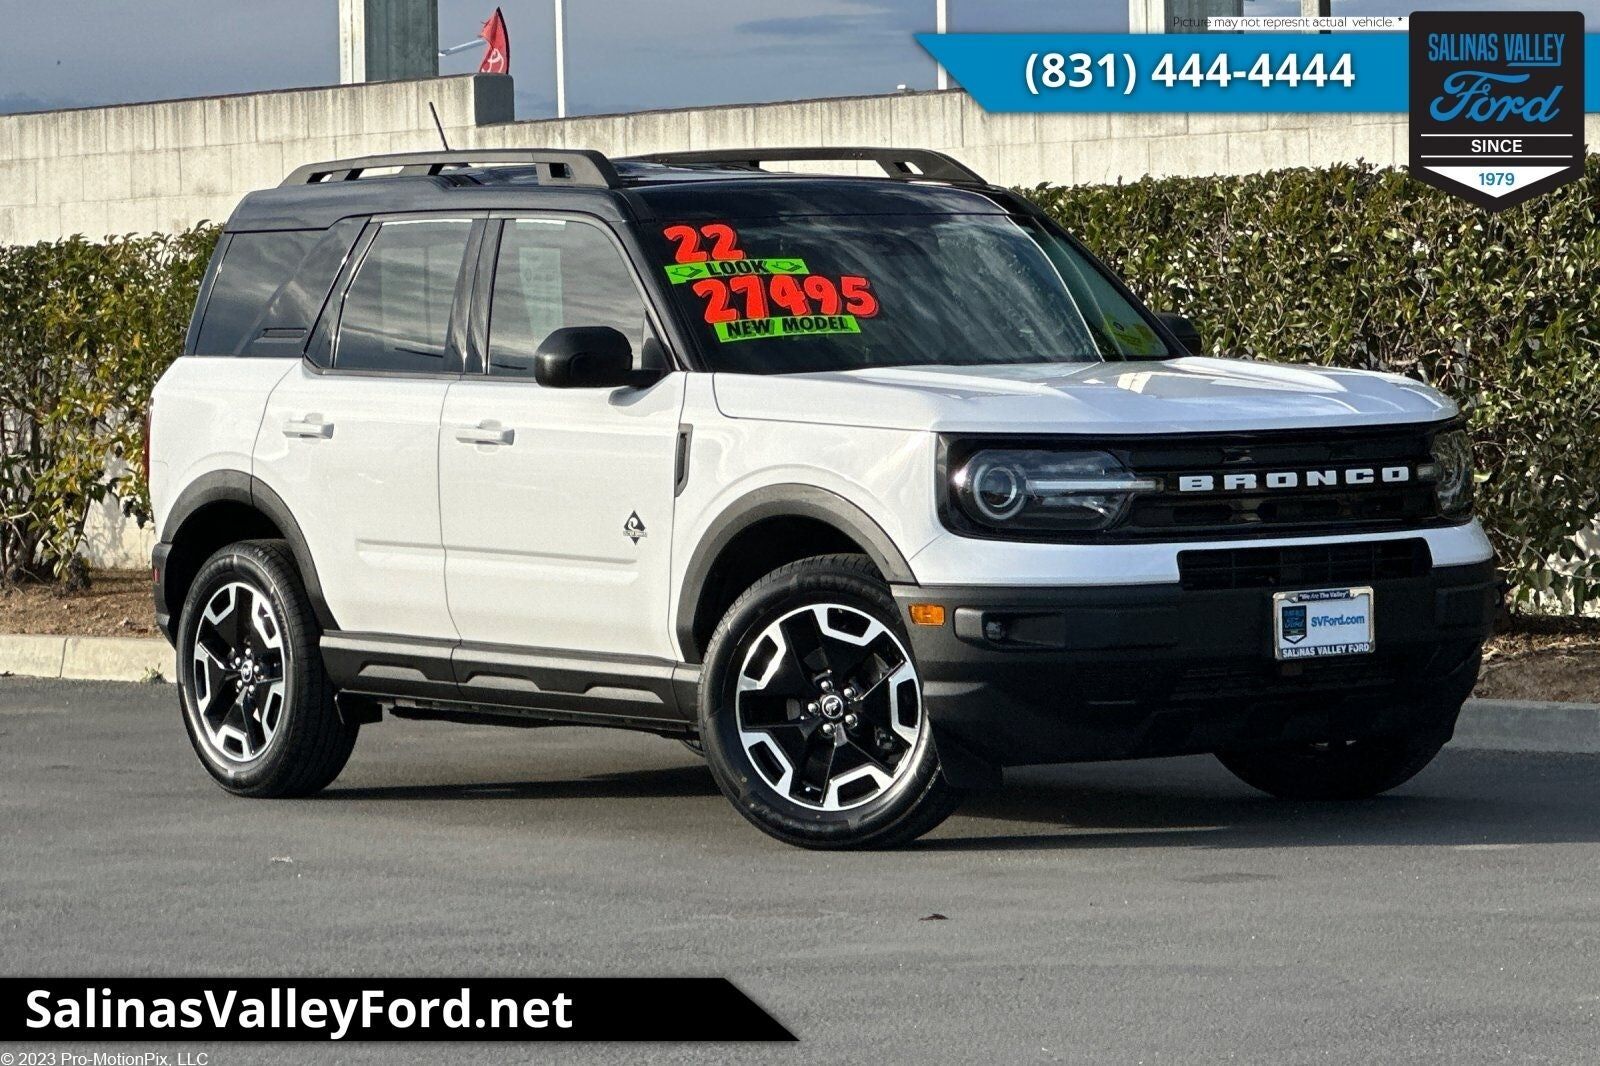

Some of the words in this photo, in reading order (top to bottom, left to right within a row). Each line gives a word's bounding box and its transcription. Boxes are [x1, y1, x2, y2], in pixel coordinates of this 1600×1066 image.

[663, 223, 744, 264] 22
[706, 259, 771, 275] LOOK
[692, 274, 879, 324] 27495
[726, 321, 775, 337] NEW
[781, 315, 853, 332] MODEL
[1179, 466, 1409, 491] BRONCO
[1311, 614, 1365, 628] SVFord.com
[1282, 648, 1315, 658] SALINAS
[1318, 645, 1347, 656] VALLEY
[1349, 643, 1370, 652] FORD
